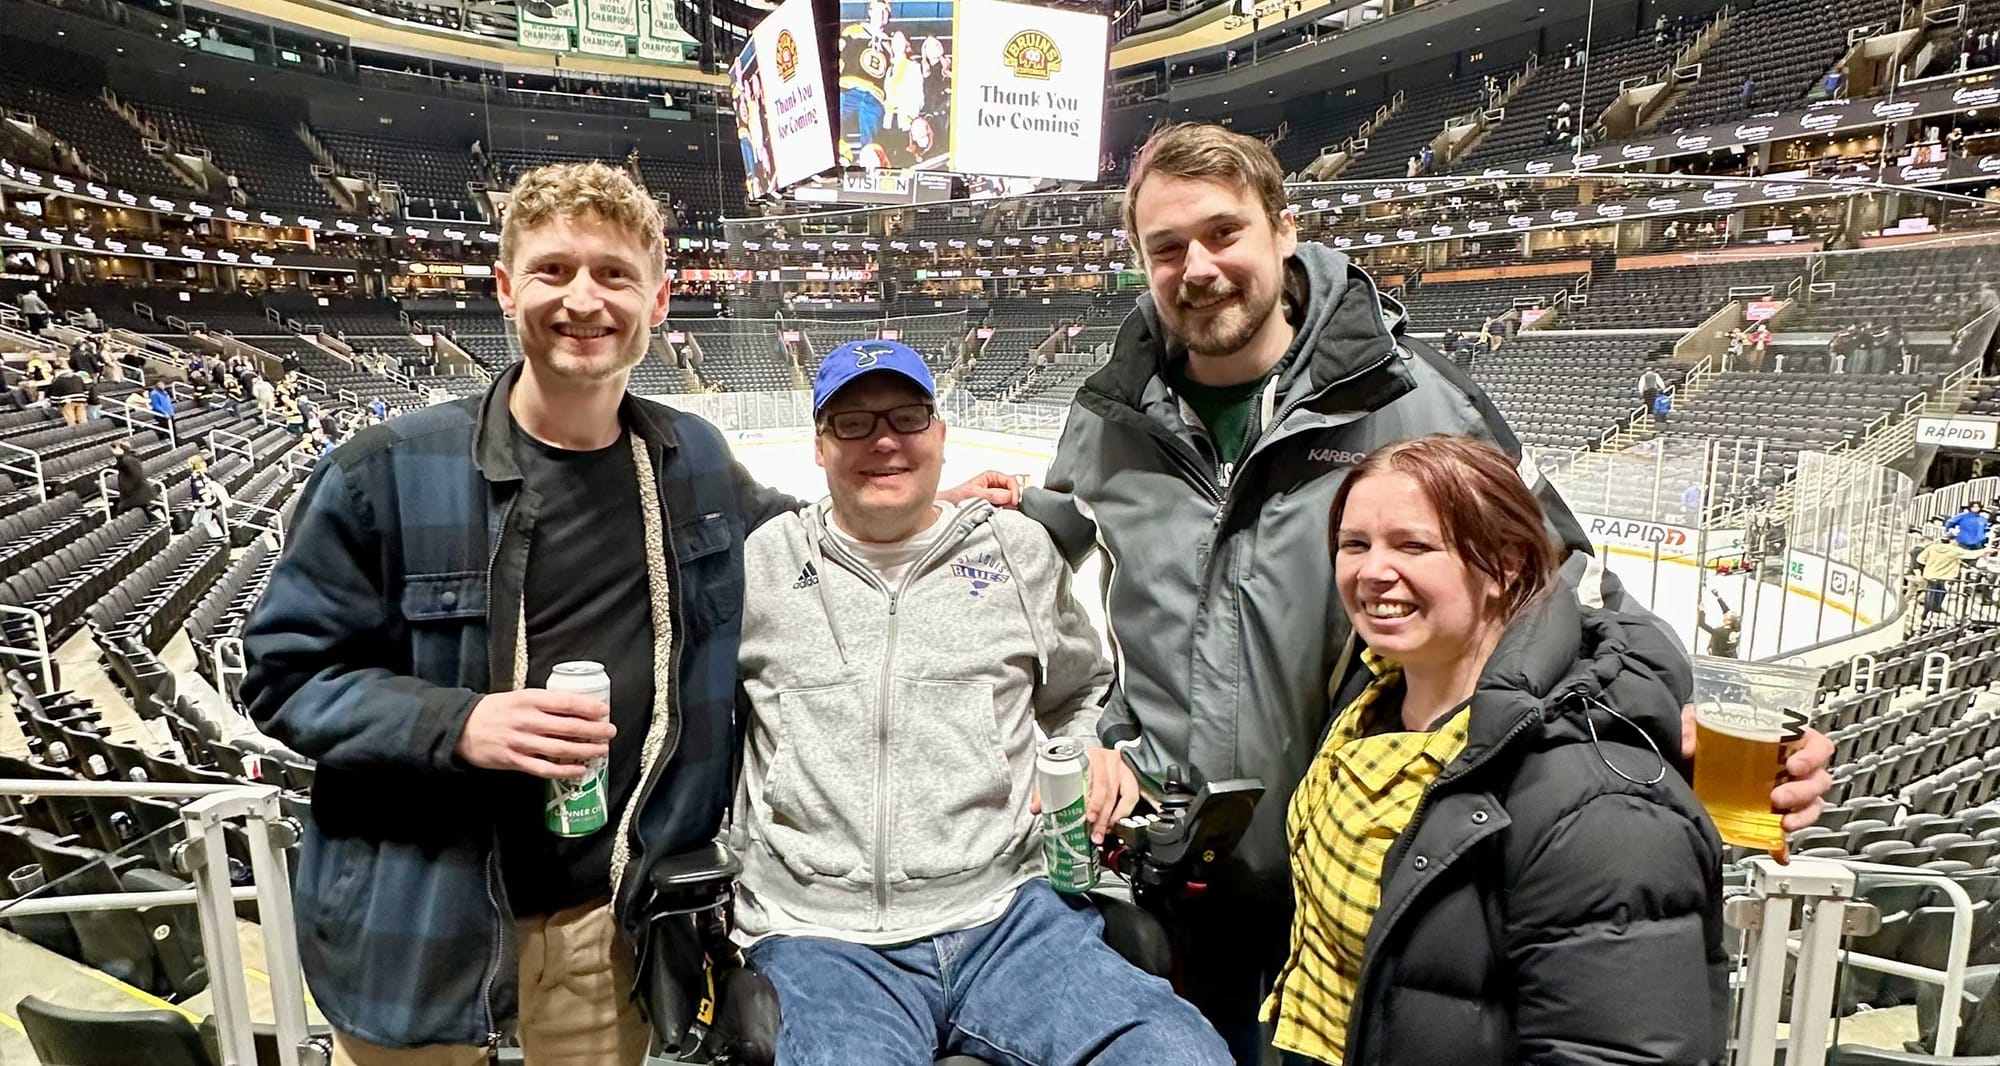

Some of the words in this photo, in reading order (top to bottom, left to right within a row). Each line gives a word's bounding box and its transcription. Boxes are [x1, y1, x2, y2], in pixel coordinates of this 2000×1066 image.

[591, 12, 634, 26] CHAMPIONS
[599, 4, 626, 15] WORLD
[1007, 33, 1058, 62] BRUINS
[775, 91, 797, 118] Thank
[980, 85, 1041, 107] Thank
[1047, 91, 1078, 111] You
[789, 107, 819, 136] Coming
[978, 108, 1006, 128] for
[1011, 112, 1080, 137] Coming
[1307, 448, 1367, 465] KARBO
[978, 553, 1007, 574] LOUIS
[792, 575, 819, 590] adida
[952, 564, 1009, 584] BLUES
[553, 808, 590, 817] BNNER
